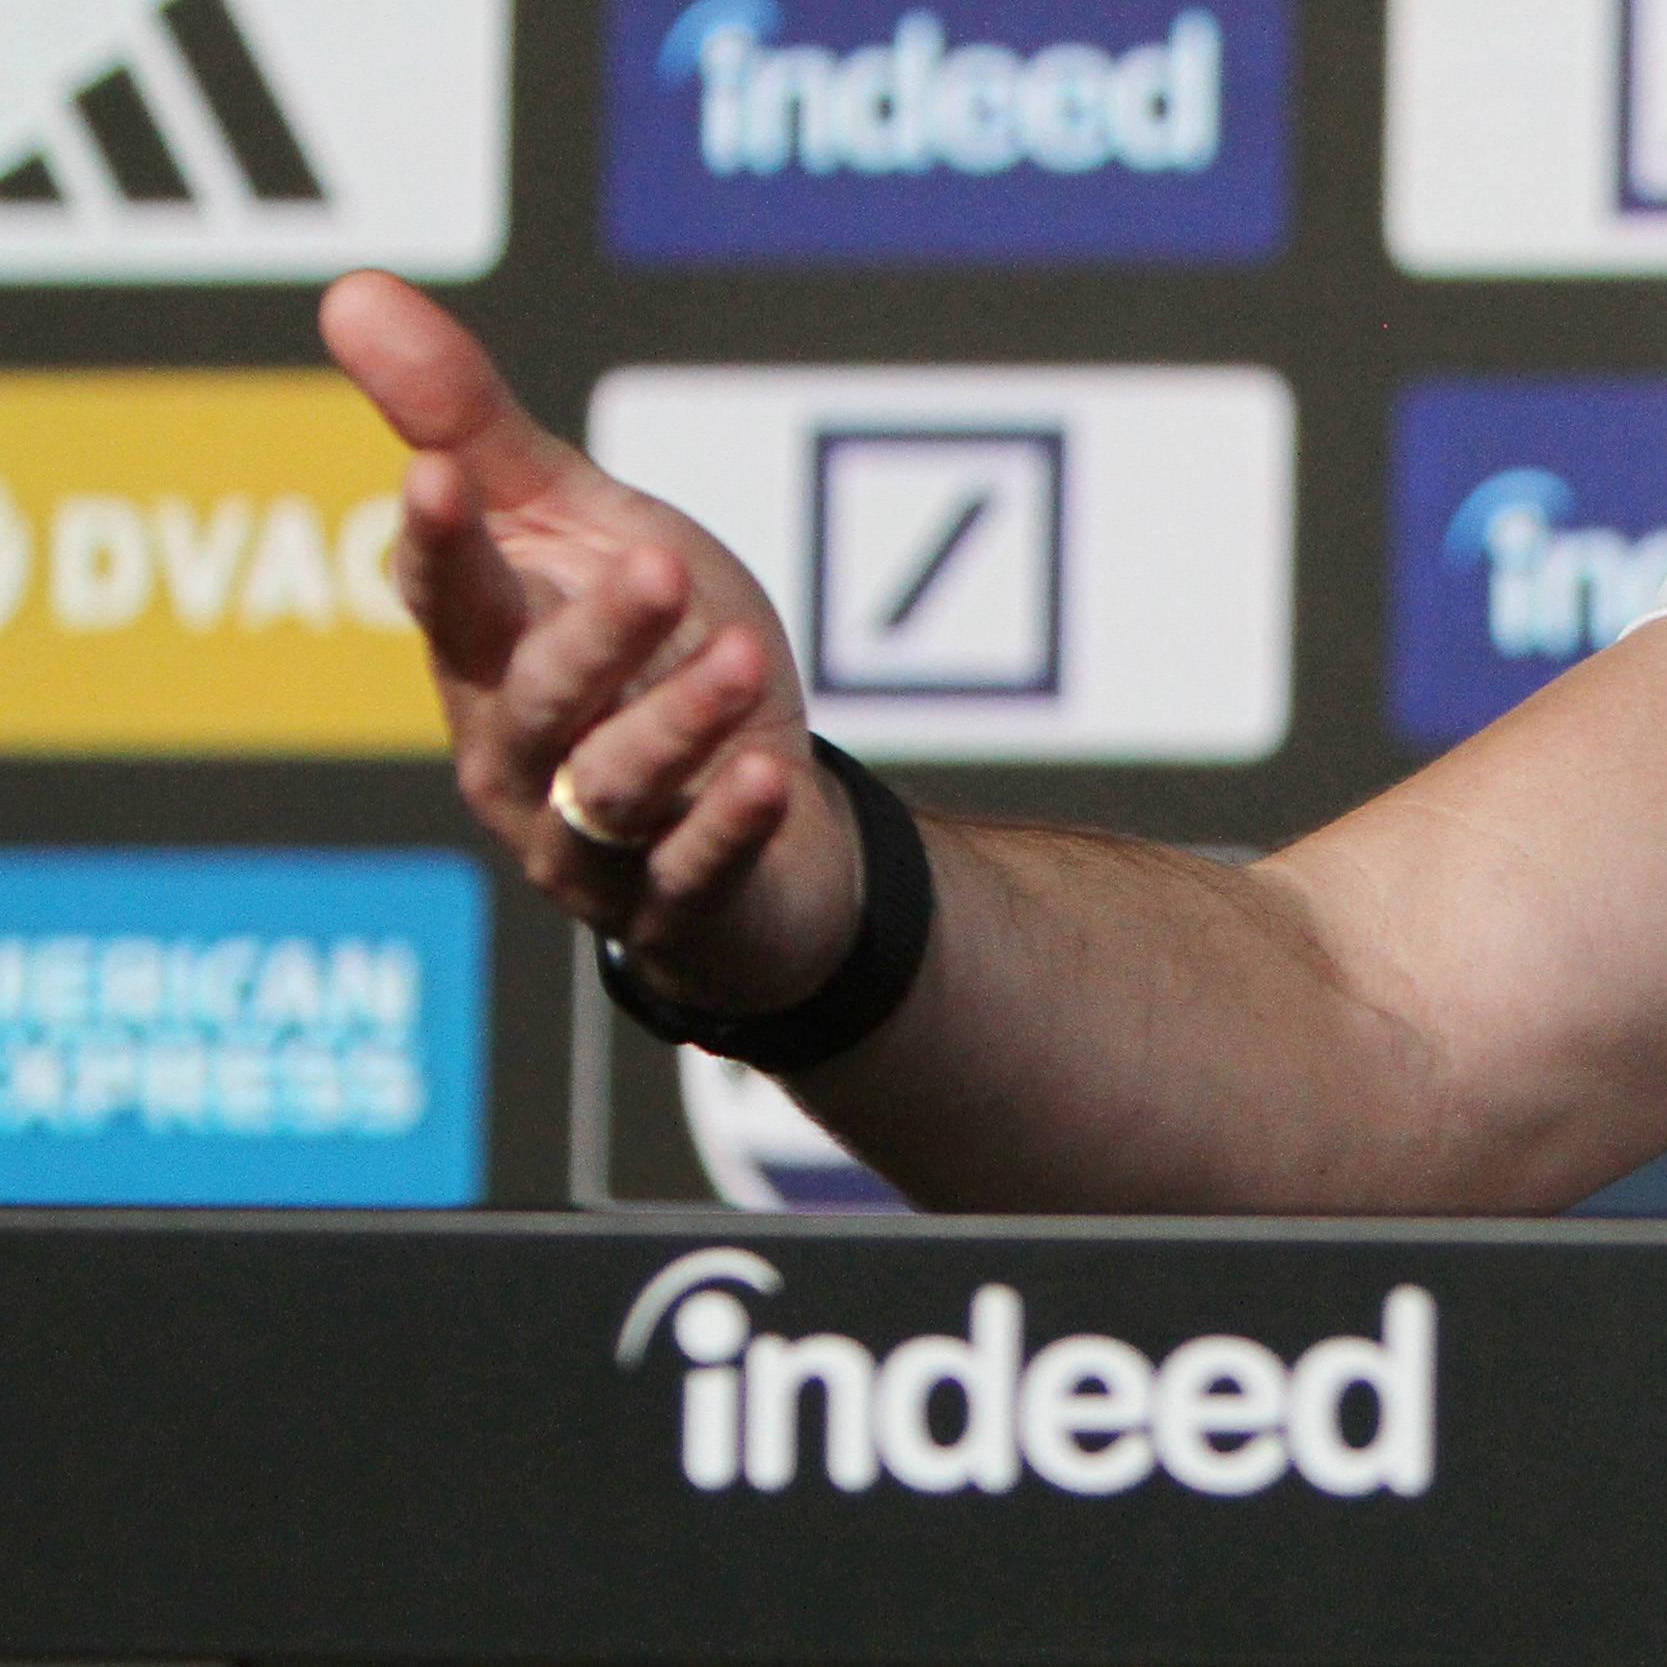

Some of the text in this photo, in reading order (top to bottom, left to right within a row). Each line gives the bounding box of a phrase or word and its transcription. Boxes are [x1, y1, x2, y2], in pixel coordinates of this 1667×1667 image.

[697, 8, 1222, 175] indeed
[0, 939, 418, 1026] ERICAN
[675, 1282, 1438, 1496] indeed
